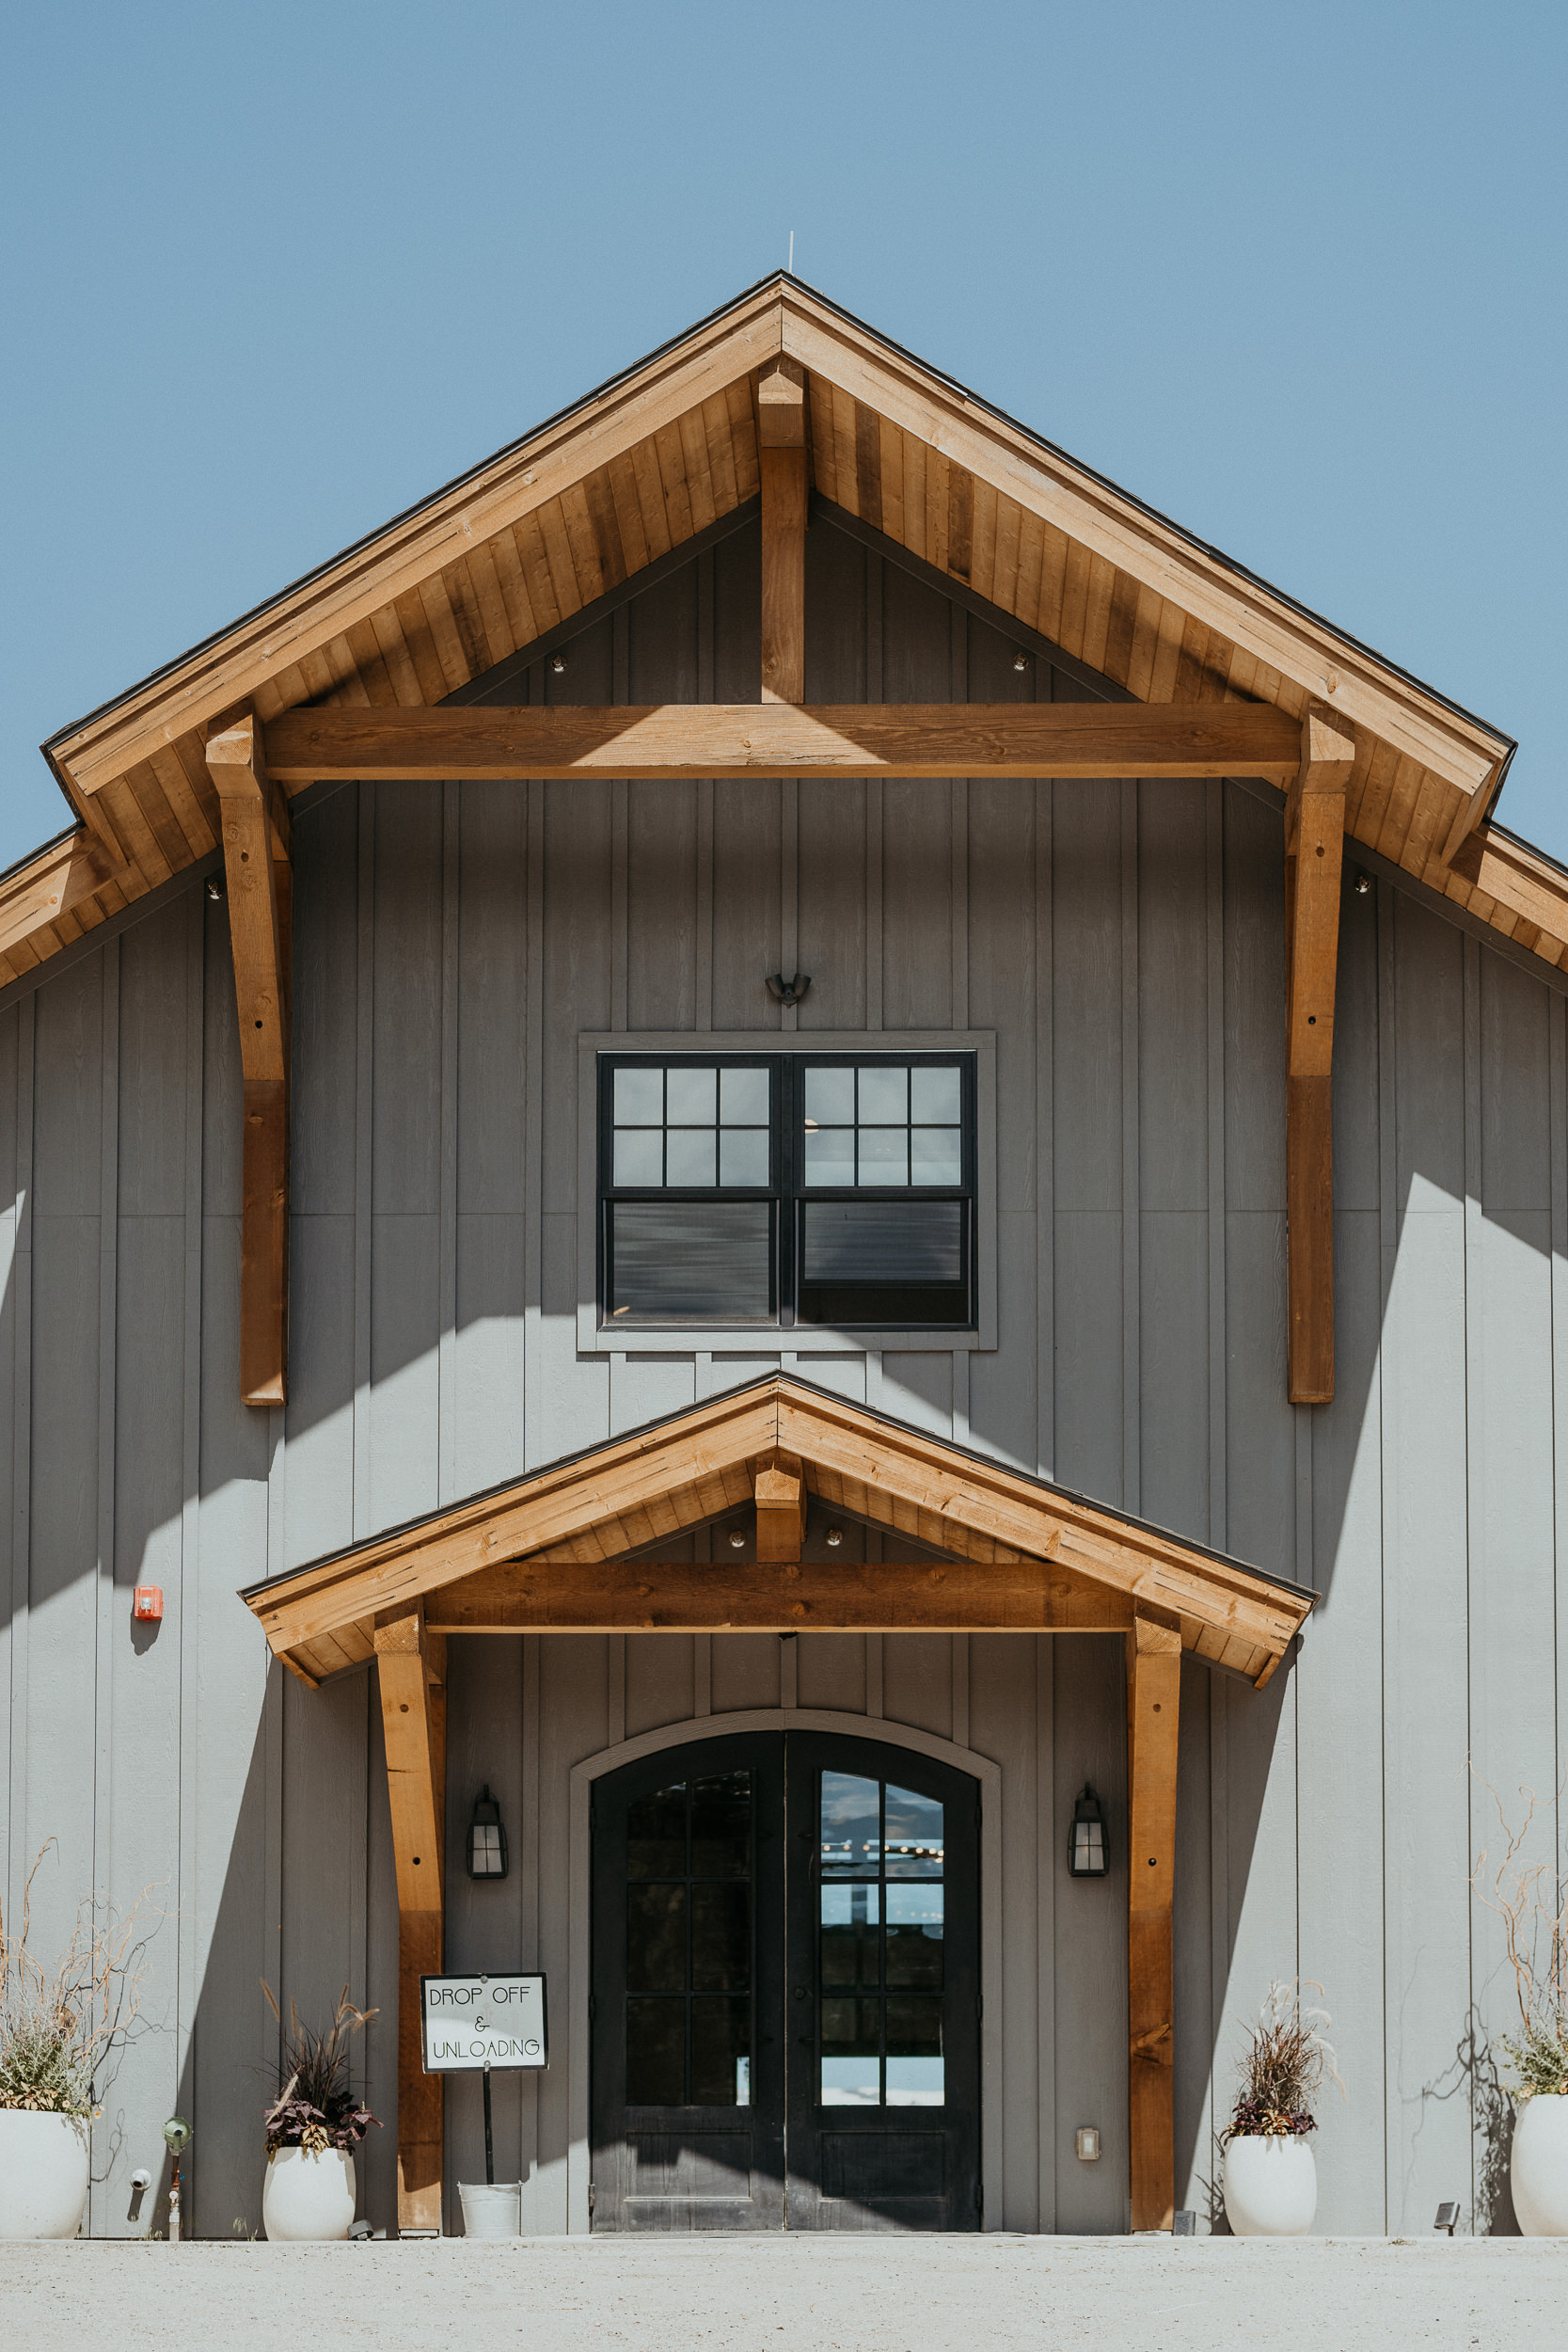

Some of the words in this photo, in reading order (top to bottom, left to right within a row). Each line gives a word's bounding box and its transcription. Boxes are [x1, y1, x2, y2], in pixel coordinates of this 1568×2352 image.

[429, 1988, 483, 2006] DROP
[492, 1986, 531, 2004] OFF
[474, 2015, 490, 2032] &
[433, 2039, 540, 2058] UNLOADING
